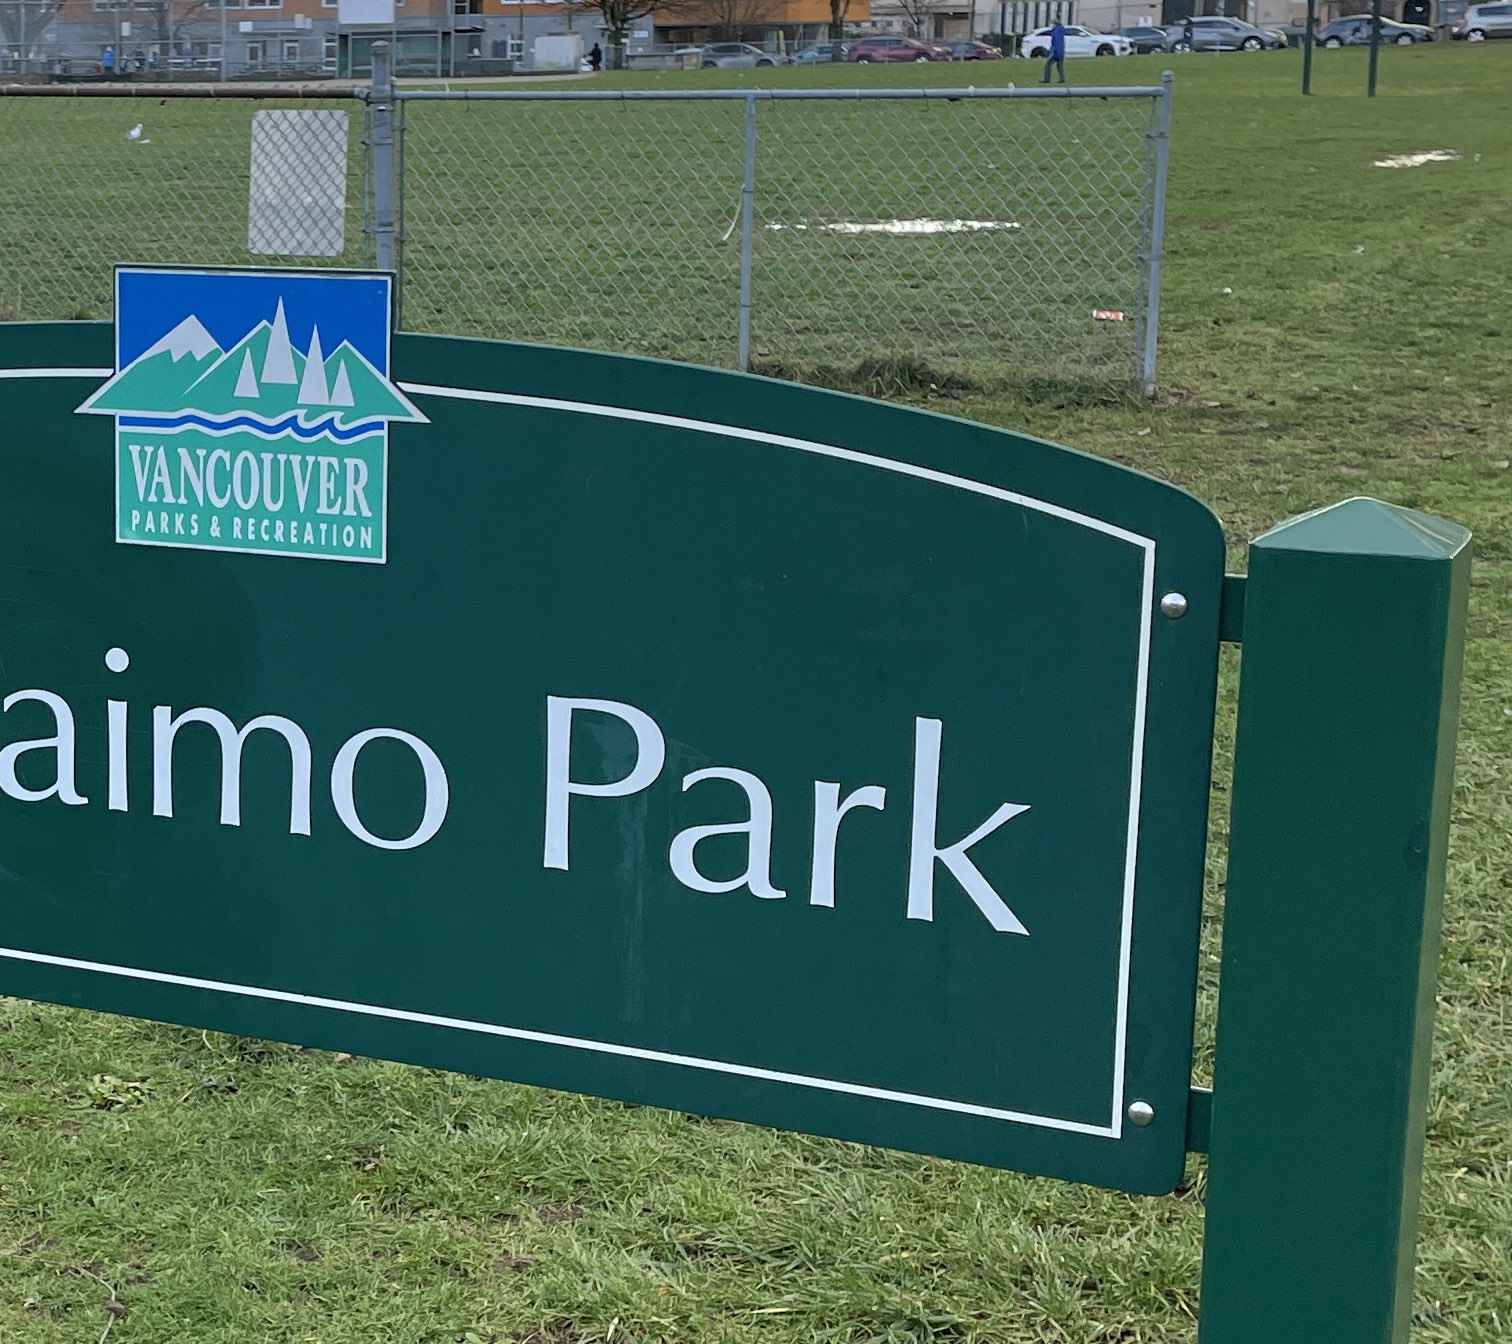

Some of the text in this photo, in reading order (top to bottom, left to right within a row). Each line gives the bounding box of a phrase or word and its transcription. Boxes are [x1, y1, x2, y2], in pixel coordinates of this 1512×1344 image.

[127, 444, 373, 517] VANCOUVER
[130, 509, 373, 549] PARKS & RECREATION
[542, 694, 1032, 938] Park
